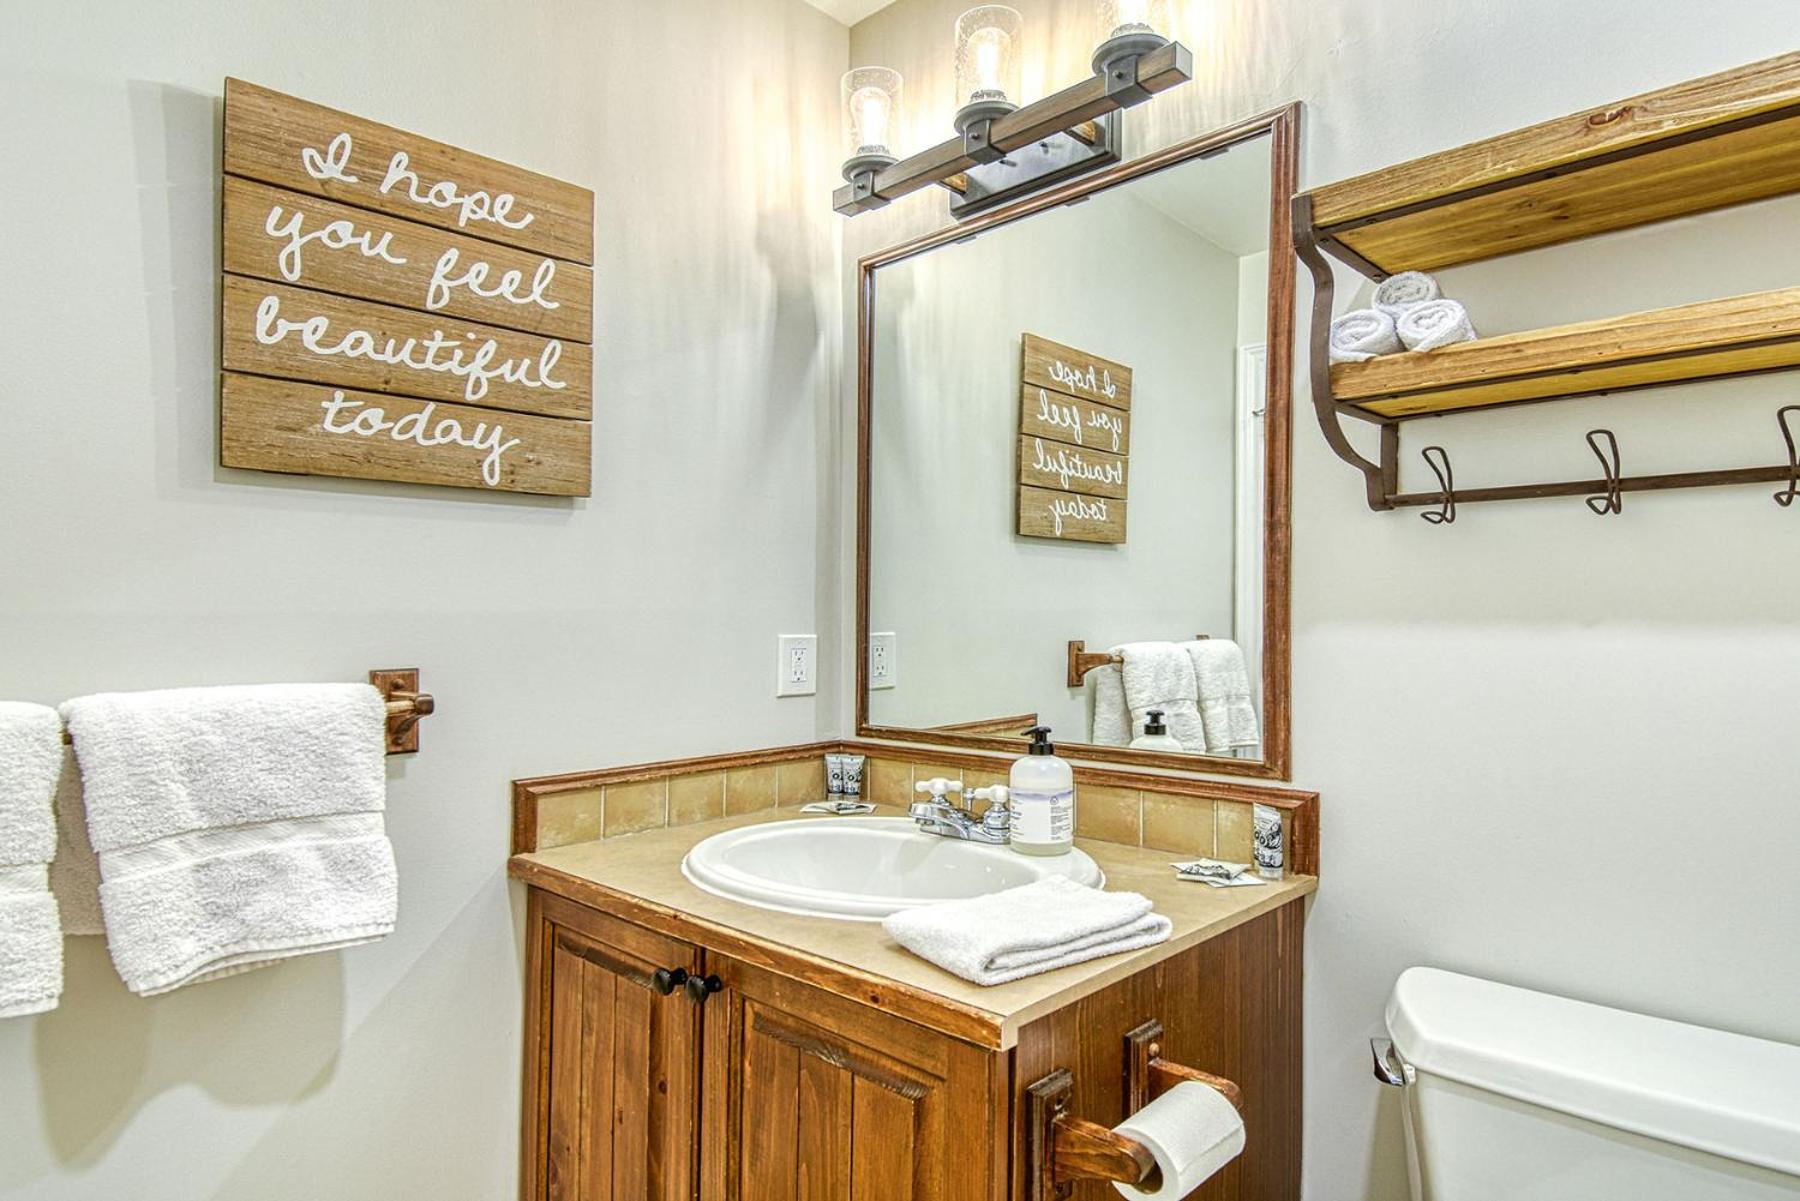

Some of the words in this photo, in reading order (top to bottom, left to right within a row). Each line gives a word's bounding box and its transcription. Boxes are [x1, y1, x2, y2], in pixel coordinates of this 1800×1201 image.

[302, 132, 358, 184] I
[379, 151, 535, 230] hope
[265, 205, 407, 282] you
[426, 247, 561, 310] feel
[255, 295, 567, 401] beautiful
[321, 390, 521, 486] today
